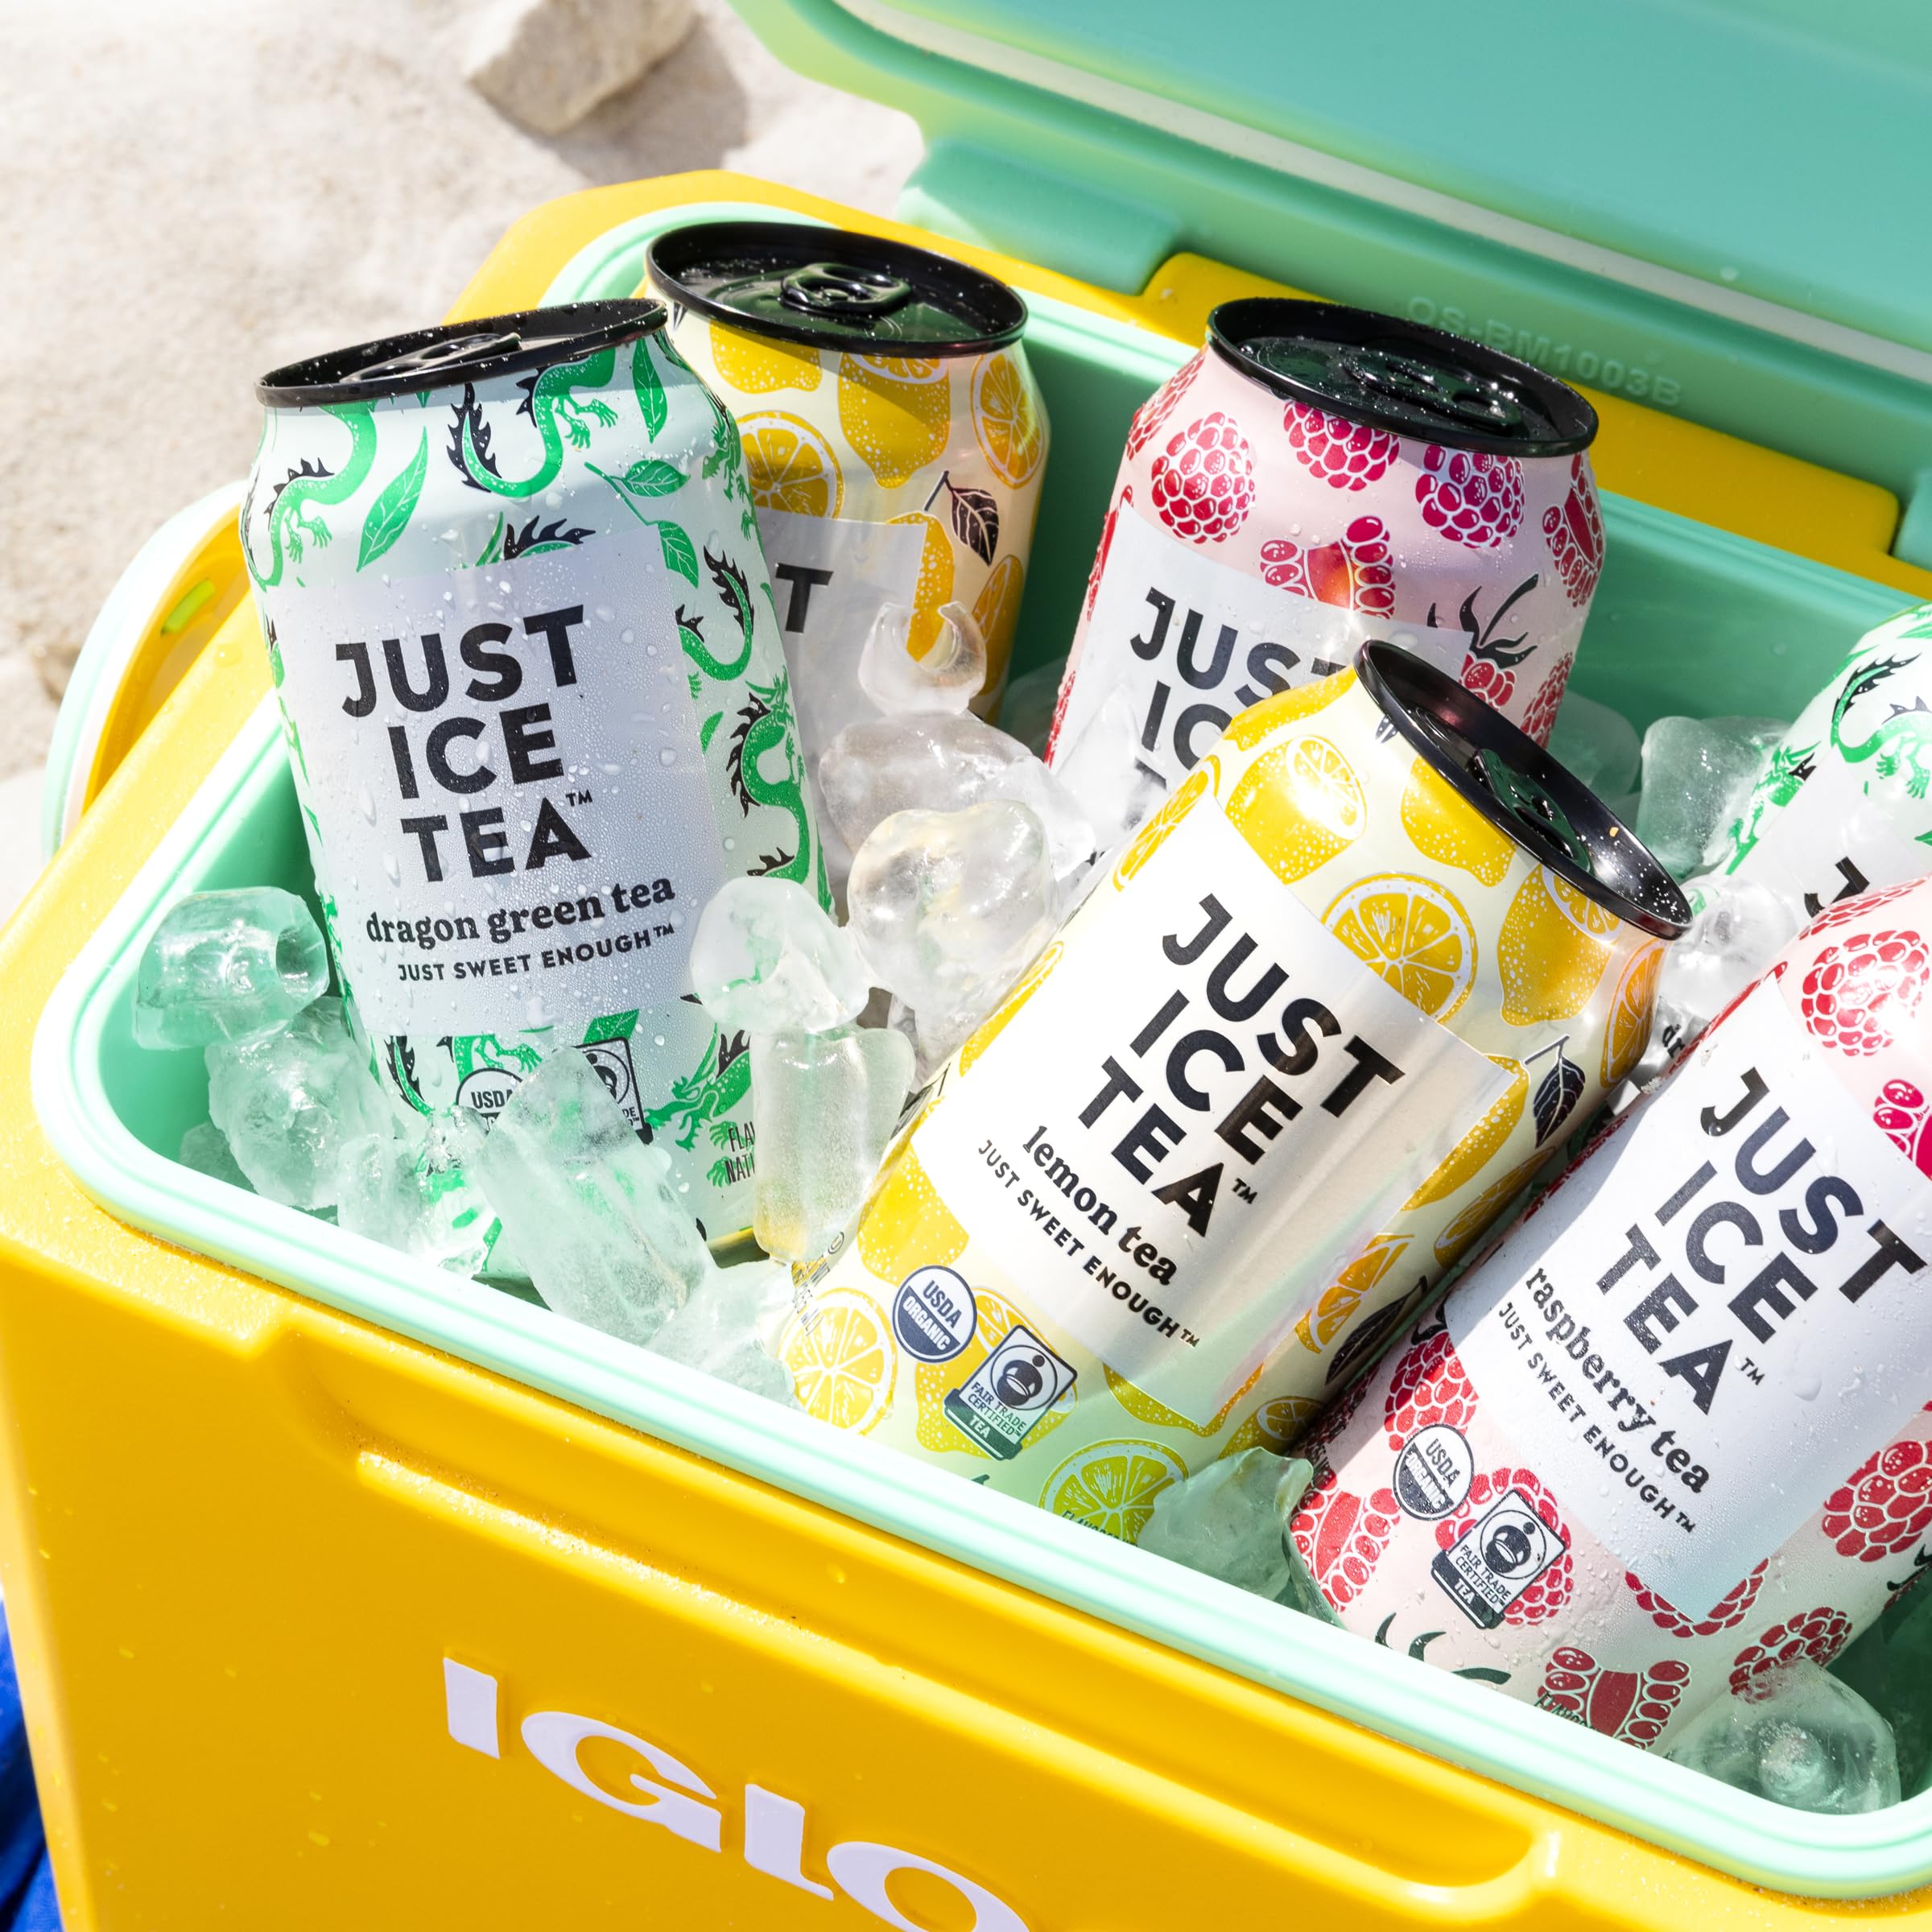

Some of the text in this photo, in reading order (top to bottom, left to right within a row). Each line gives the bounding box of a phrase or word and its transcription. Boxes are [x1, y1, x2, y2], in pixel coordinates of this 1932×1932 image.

[335, 605, 584, 717] JUST
[386, 703, 564, 799] ICE
[366, 877, 675, 949] dragon green tea
[398, 963, 444, 981] JUST
[455, 955, 530, 979] SWEET
[1162, 893, 1406, 1118] JUST
[1129, 989, 1303, 1166] ICE
[978, 1140, 1021, 1188] JUST
[1017, 1189, 1084, 1255] SWEET
[1022, 1125, 1175, 1285] lemon tea
[1700, 1067, 1927, 1303] JUST
[1654, 1160, 1818, 1344] ICE
[903, 1296, 951, 1351] ORGANIC
[923, 1280, 962, 1328] USDA
[1499, 1302, 1533, 1354] JUST
[1527, 1353, 1585, 1423] SWEET
[1526, 1267, 1709, 1492] raspberry tea
[970, 1415, 990, 1439] TEA
[971, 1382, 1026, 1431] FAIR TRADE
[1406, 1452, 1446, 1509] ORGANIC
[1426, 1439, 1460, 1488] USDA
[1453, 1578, 1476, 1604] TEA
[1460, 1545, 1511, 1600] FAIR TRADE
